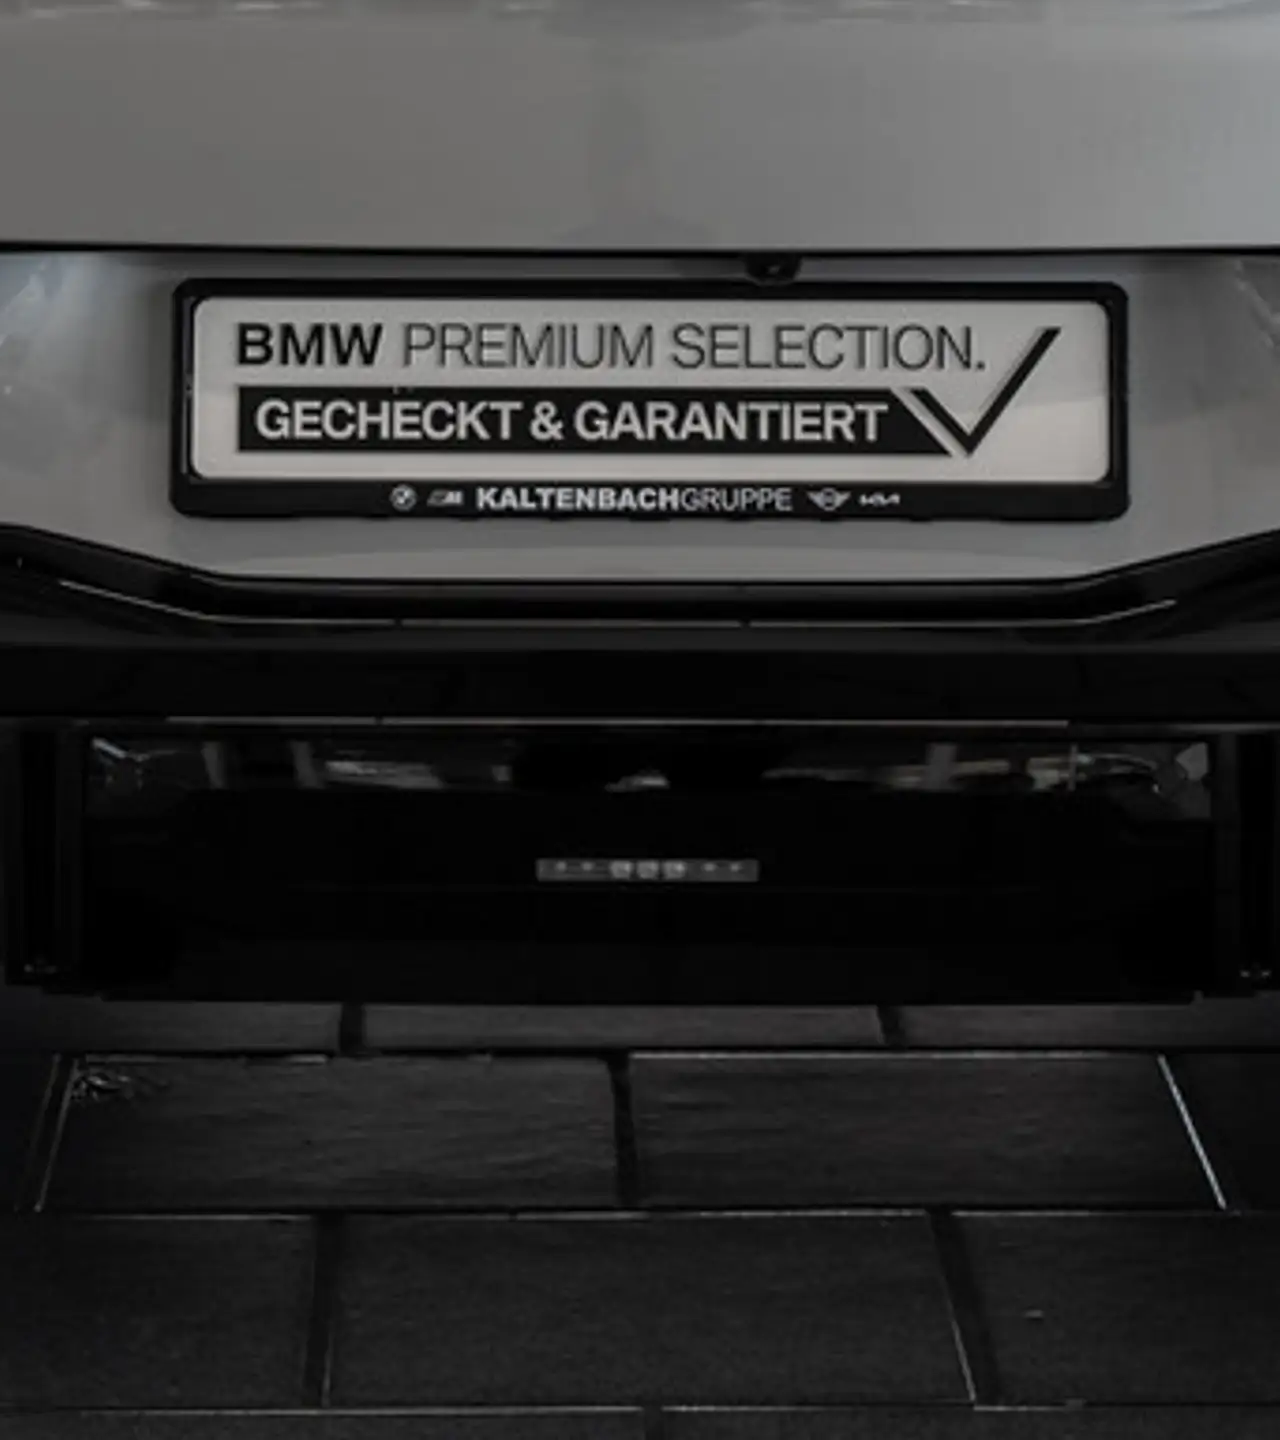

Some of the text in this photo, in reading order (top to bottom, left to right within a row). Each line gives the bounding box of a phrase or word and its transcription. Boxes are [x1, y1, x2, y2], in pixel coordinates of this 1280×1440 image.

[236, 322, 986, 371] BMW PREMIUM SELECTION.
[255, 399, 889, 442] GECHECKT & GARANTIERT
[475, 486, 794, 511] KALTENBACHGRUPPE
